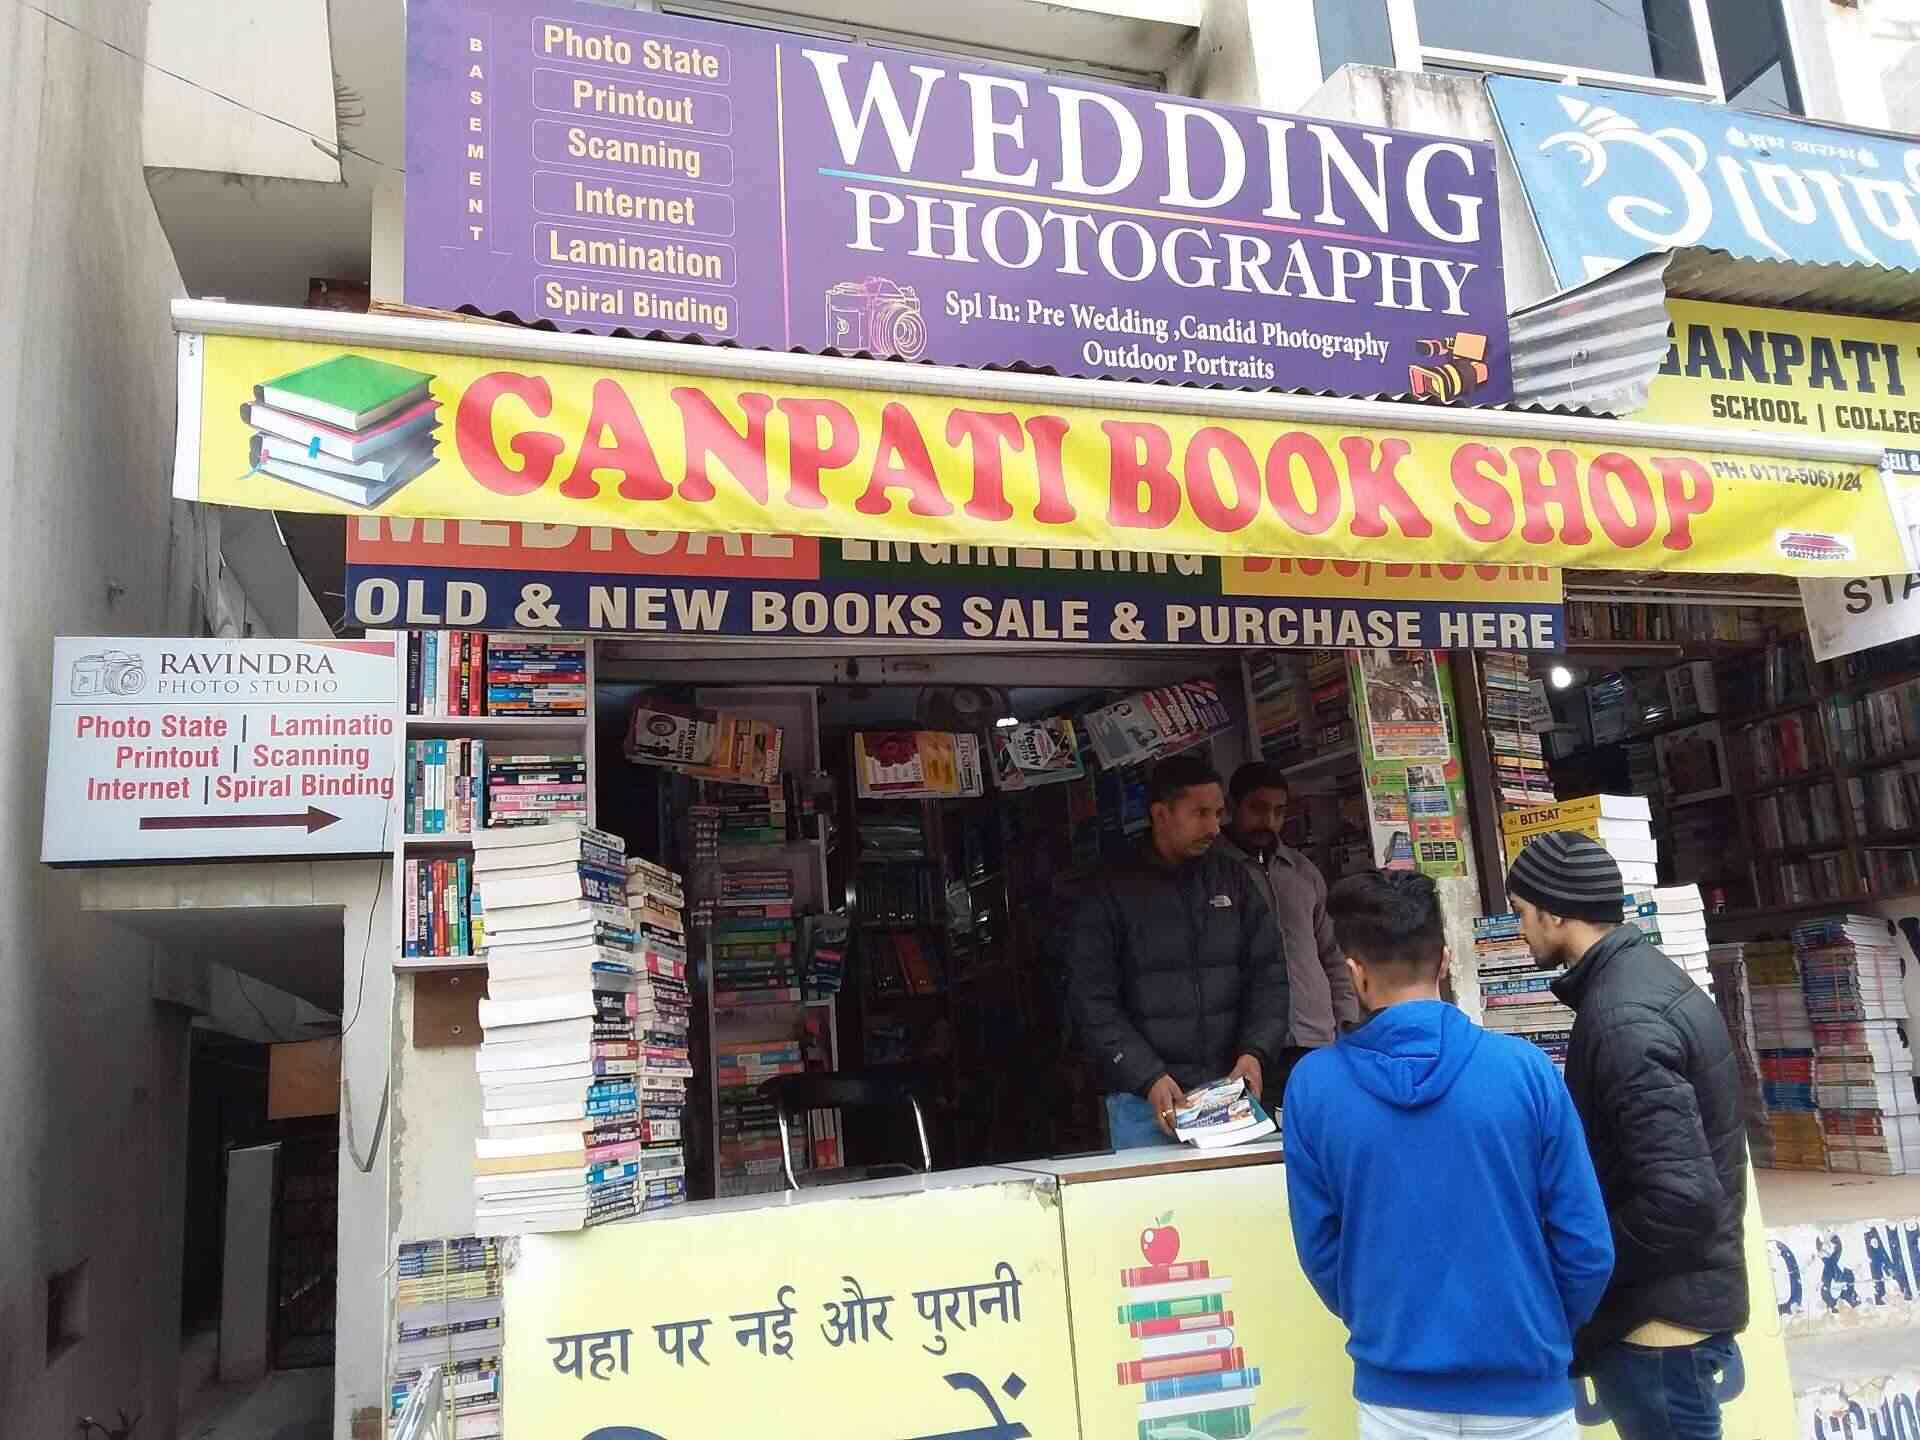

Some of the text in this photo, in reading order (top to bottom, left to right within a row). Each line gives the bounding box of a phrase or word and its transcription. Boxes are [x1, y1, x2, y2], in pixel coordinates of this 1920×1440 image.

[543, 24, 720, 78] Photo State
[573, 79, 695, 125] Printout
[466, 37, 485, 241] BASEMENT
[567, 128, 701, 178] Scanning
[801, 48, 1484, 243] WEDDING
[574, 181, 696, 227] Internet
[549, 230, 722, 280] Lamination
[844, 185, 1479, 317] PHOTOGRAPHY
[545, 280, 729, 331] Spiral Binding
[944, 290, 984, 325] Spl
[988, 295, 1021, 322] In:
[1026, 298, 1065, 327] Pre
[1070, 303, 1168, 342] Wedding
[1261, 321, 1390, 365] Photography
[1082, 340, 1275, 380] Outdoor Portraits
[1710, 394, 1808, 425] SCHOOL
[455, 370, 1715, 552] GANPATI BOOK SHOP
[1711, 460, 1747, 479] PH:
[353, 577, 1555, 649] OLD & NEW BOOKS SALE & PURCHASE HERE
[157, 678, 339, 695] PHOTO STUDIO
[160, 652, 337, 675] RAVINDRA
[75, 713, 393, 739] Photo State Laminatio
[116, 744, 370, 770] Printout Scanning
[87, 773, 394, 803] Internet Spiral Binding
[1519, 807, 1561, 826] BITSAT
[547, 1261, 1023, 1381] यहा पर नई और पुरानी
